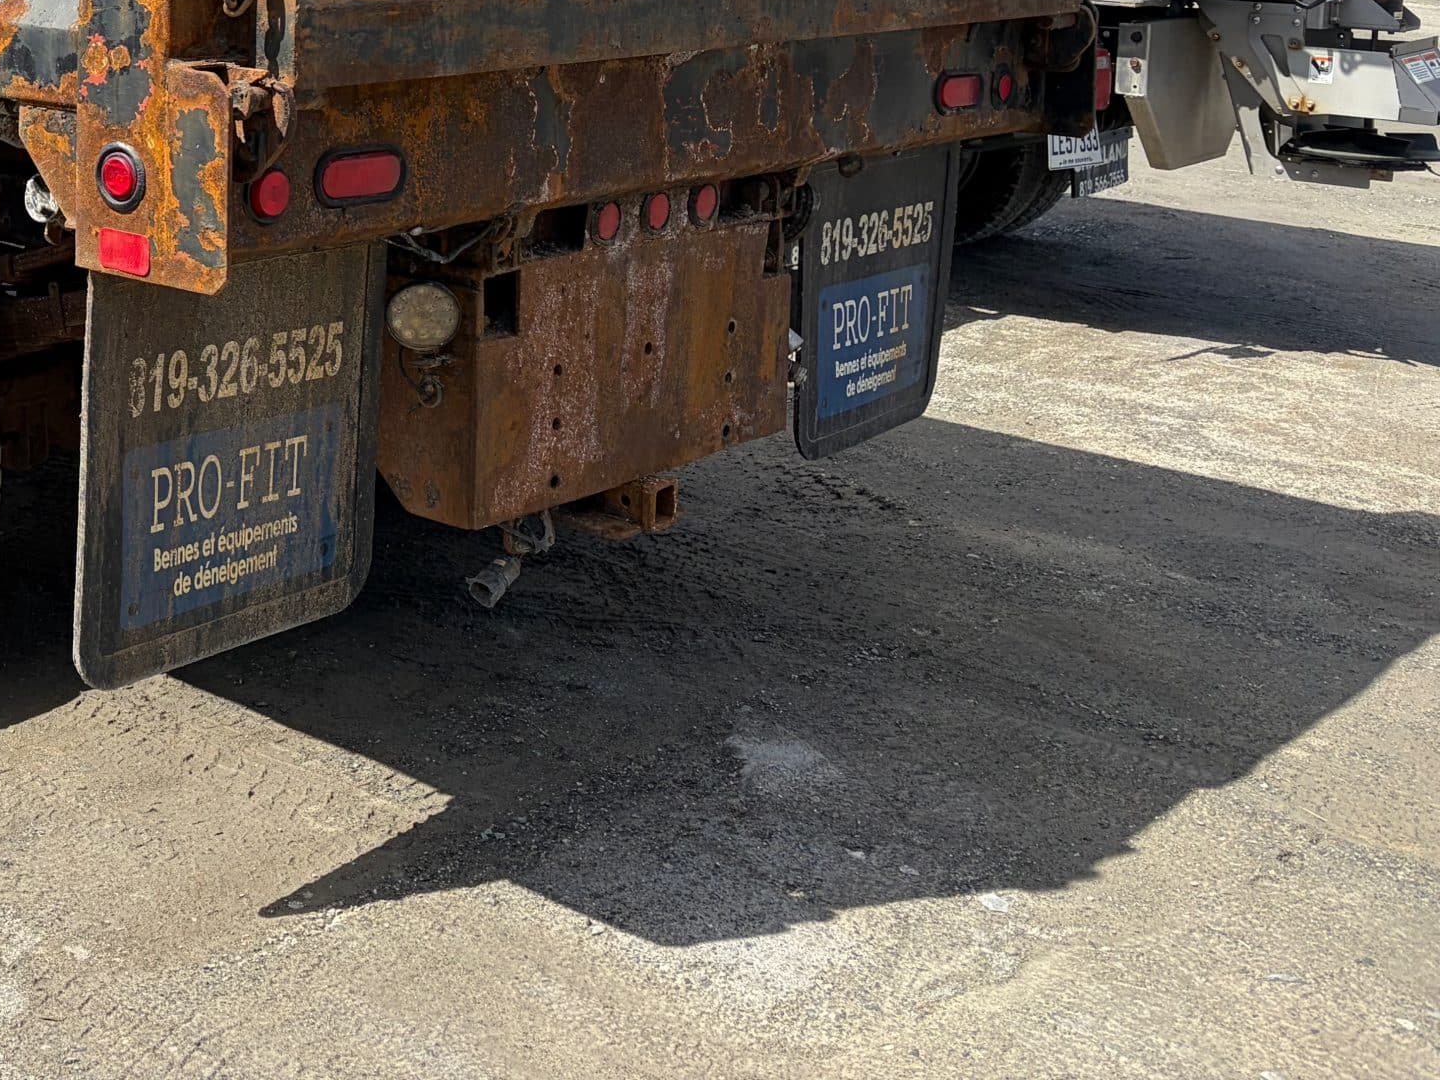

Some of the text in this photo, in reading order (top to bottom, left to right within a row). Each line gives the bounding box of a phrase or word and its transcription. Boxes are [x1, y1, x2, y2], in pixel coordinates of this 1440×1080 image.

[820, 201, 934, 266] 819-326-5525
[832, 284, 913, 351] PRO-FIT
[835, 340, 907, 378] Bennes et équipements
[846, 364, 897, 397] de déneigement
[150, 435, 309, 534] PRO-FIT
[153, 511, 298, 572] Bennes et équipements
[173, 544, 278, 597] de déneigement
